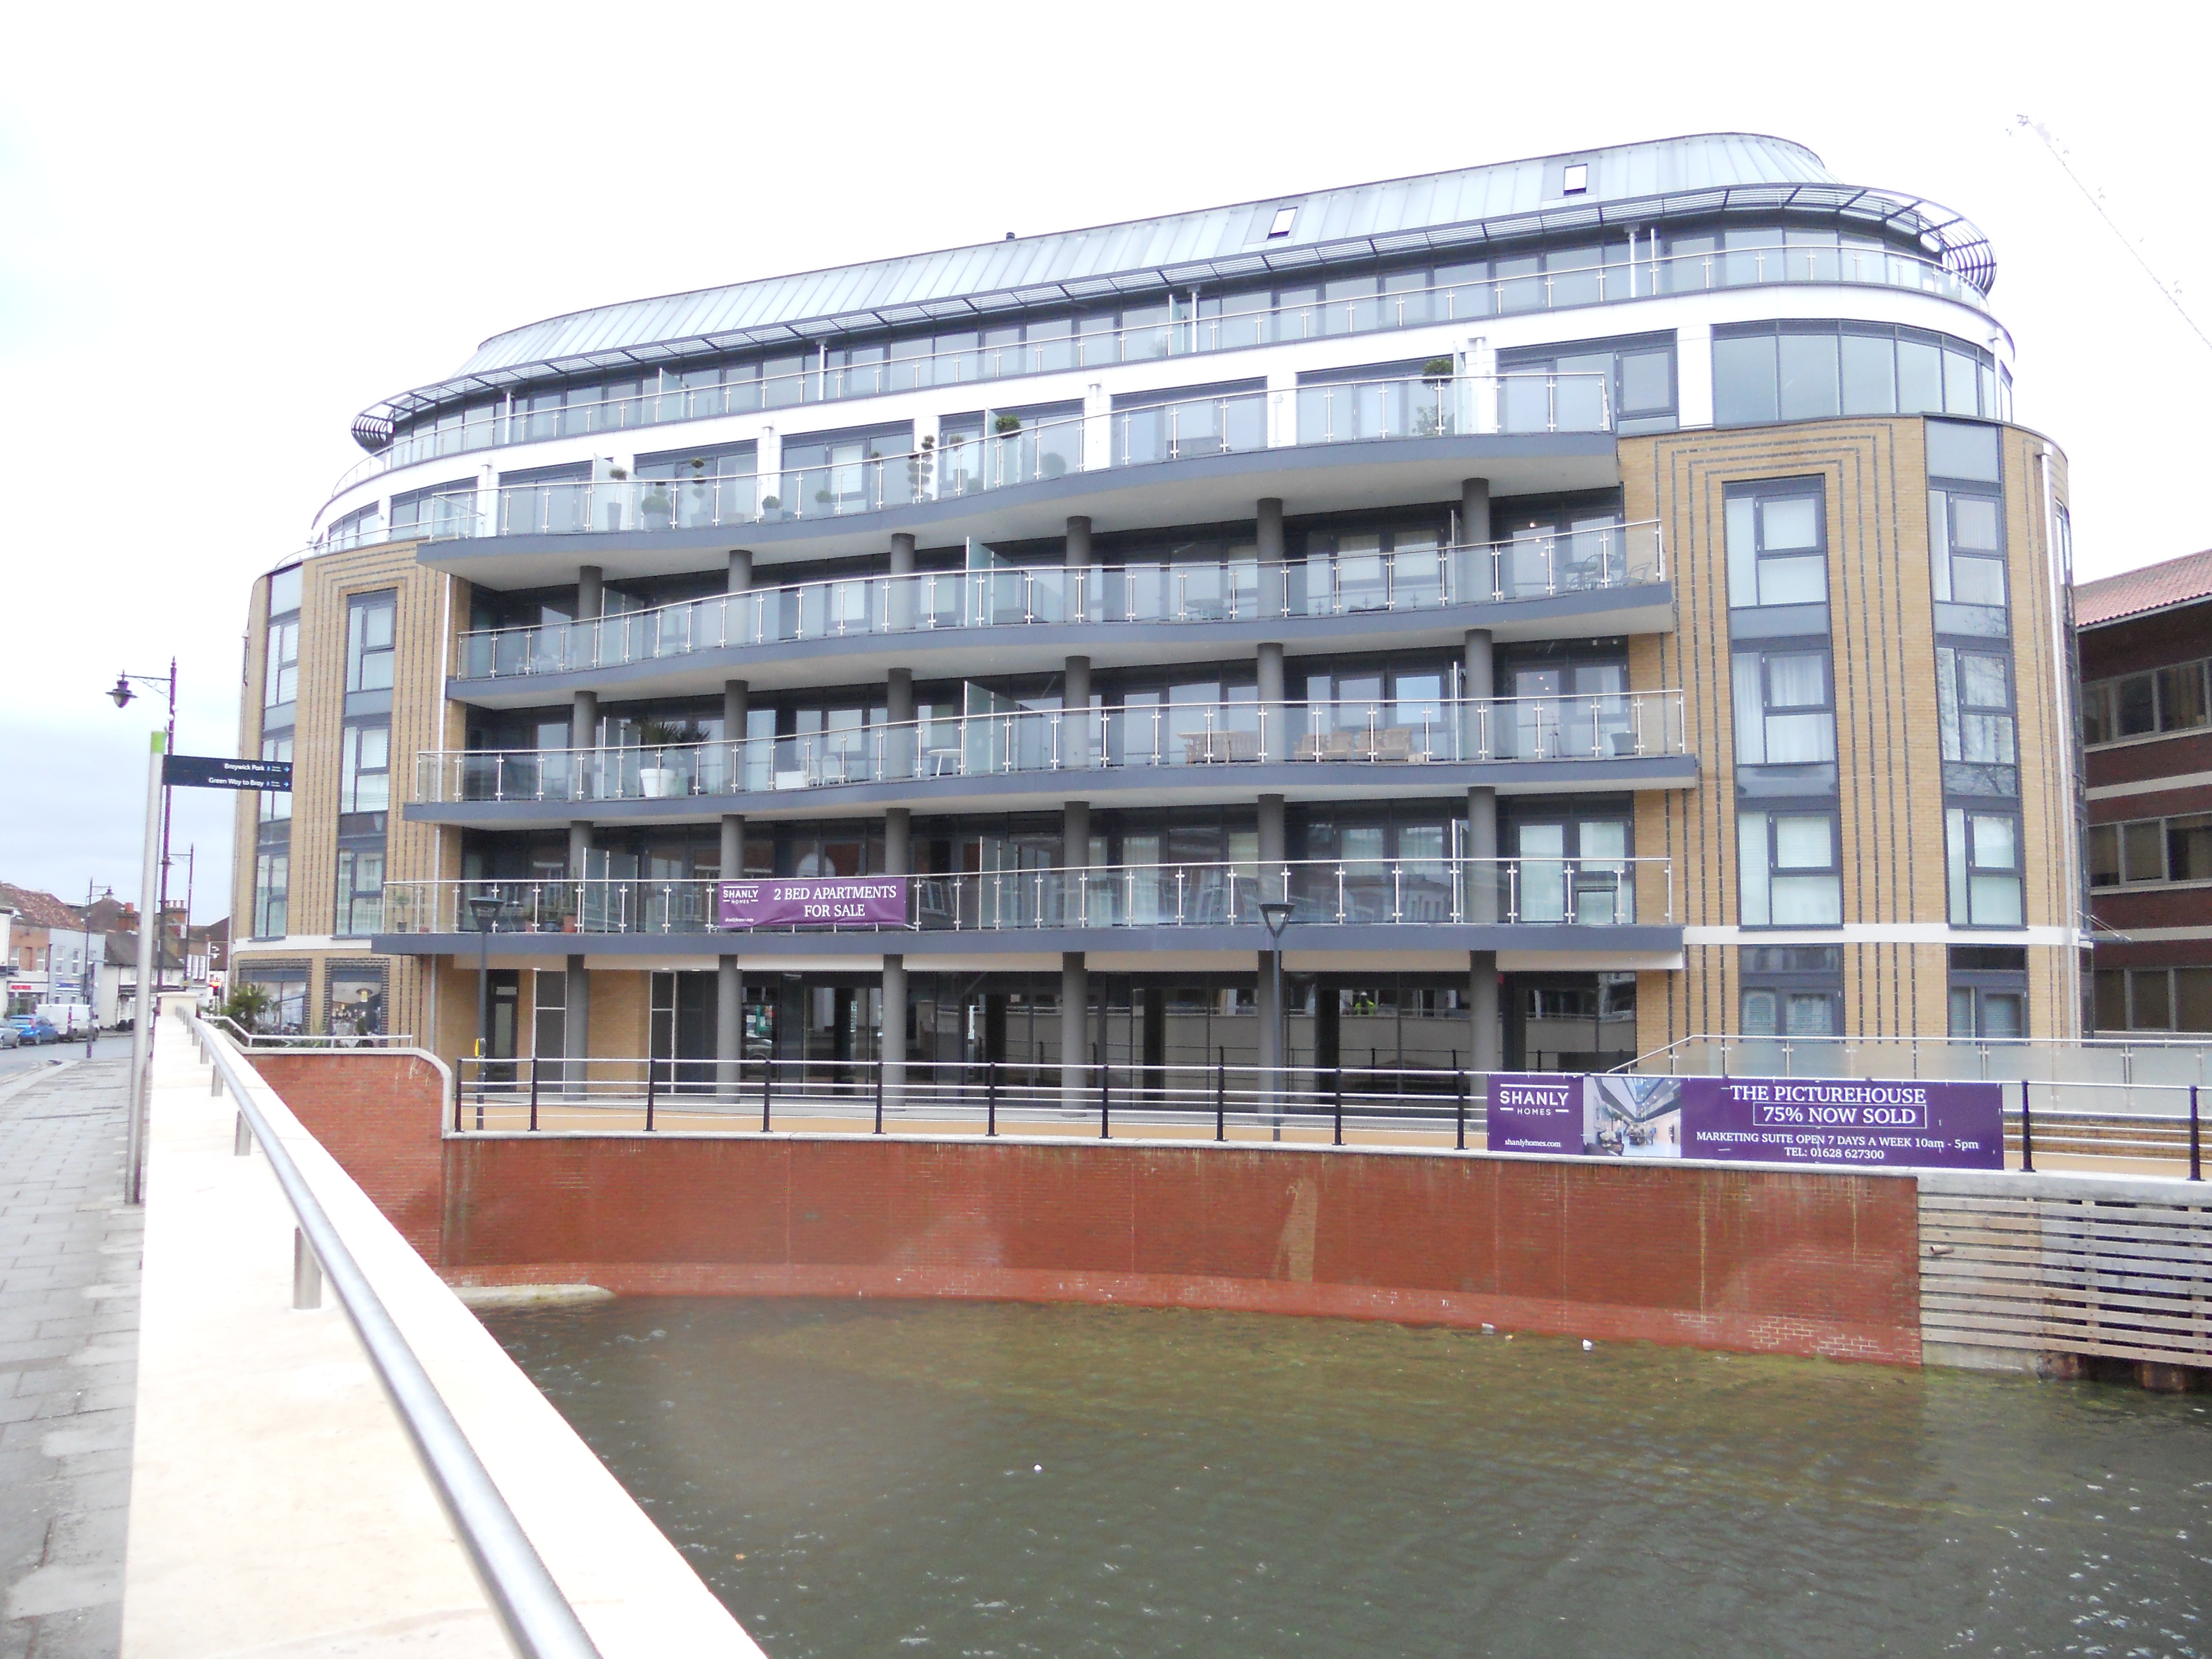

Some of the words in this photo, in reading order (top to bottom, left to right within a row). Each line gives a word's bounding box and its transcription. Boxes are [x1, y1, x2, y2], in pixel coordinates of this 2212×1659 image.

[224, 763, 250, 771] Braywick
[228, 778, 241, 786] Way
[723, 890, 759, 898] SHANLY
[774, 888, 781, 900] 2
[785, 888, 810, 900] BED
[813, 885, 897, 900] APARTMENTS
[804, 904, 831, 917] FOR
[834, 904, 865, 917] SALE
[1500, 1091, 1569, 1105] SHANLY
[1729, 1085, 1768, 1100] THE
[1774, 1086, 1926, 1104] PICTUREHOUSE
[1763, 1107, 1803, 1122] 75%
[1808, 1108, 1857, 1123] NOW
[1863, 1108, 1916, 1124] SOLD
[1505, 1138, 1561, 1147] shanlyhomes.com
[1696, 1131, 1759, 1142] MARKETING
[1761, 1133, 1793, 1143] SUITE
[1796, 1134, 1825, 1144] OPEN
[1828, 1136, 1834, 1145] 7
[1837, 1136, 1865, 1145] DAYS
[1868, 1137, 1876, 1146] A
[1879, 1138, 1912, 1147] WEEK
[1915, 1138, 1944, 1148] 10am
[1954, 1139, 1979, 1151] 5pm
[1784, 1147, 1807, 1156] TEL:
[1811, 1147, 1842, 1157] 01628
[1845, 1149, 1884, 1159] 627300
